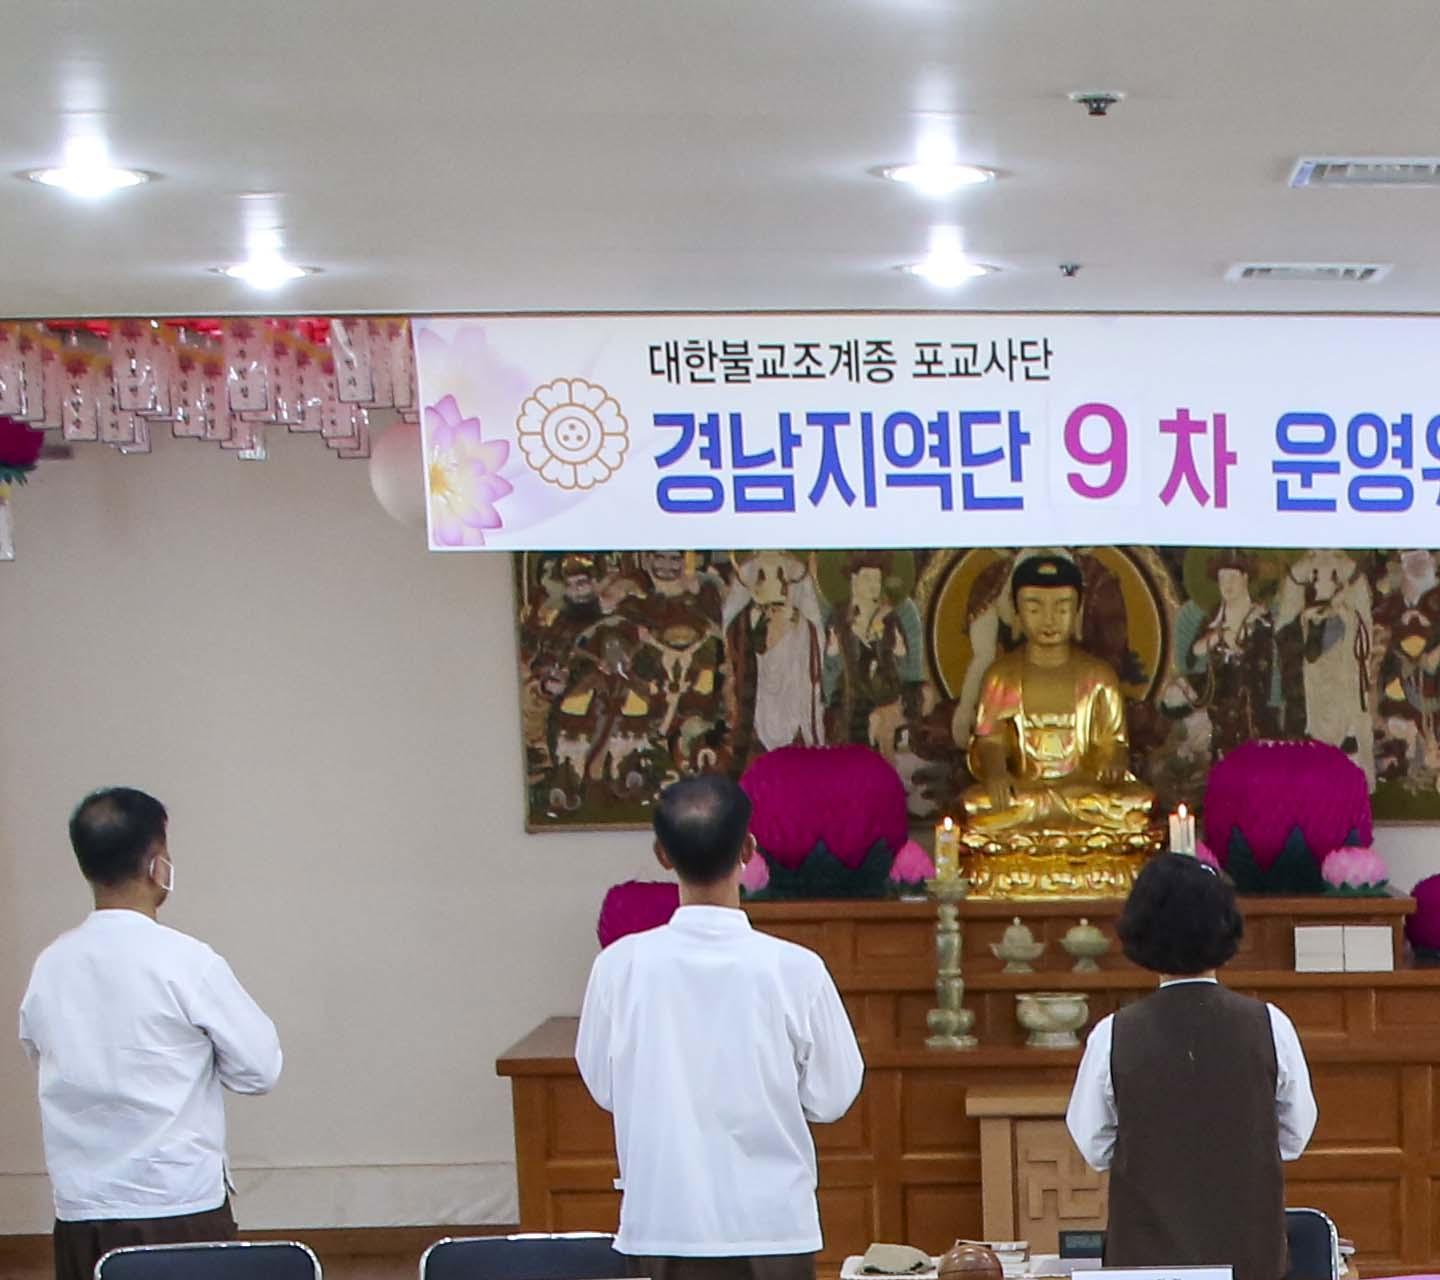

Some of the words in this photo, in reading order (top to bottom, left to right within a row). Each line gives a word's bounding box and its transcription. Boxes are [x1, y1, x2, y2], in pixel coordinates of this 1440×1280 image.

[649, 339, 898, 383] 대한불교조계종
[912, 337, 1053, 381] 포교사단
[651, 407, 1031, 514] 경남지역단
[1062, 402, 1130, 500] 9
[1158, 408, 1237, 508] 차
